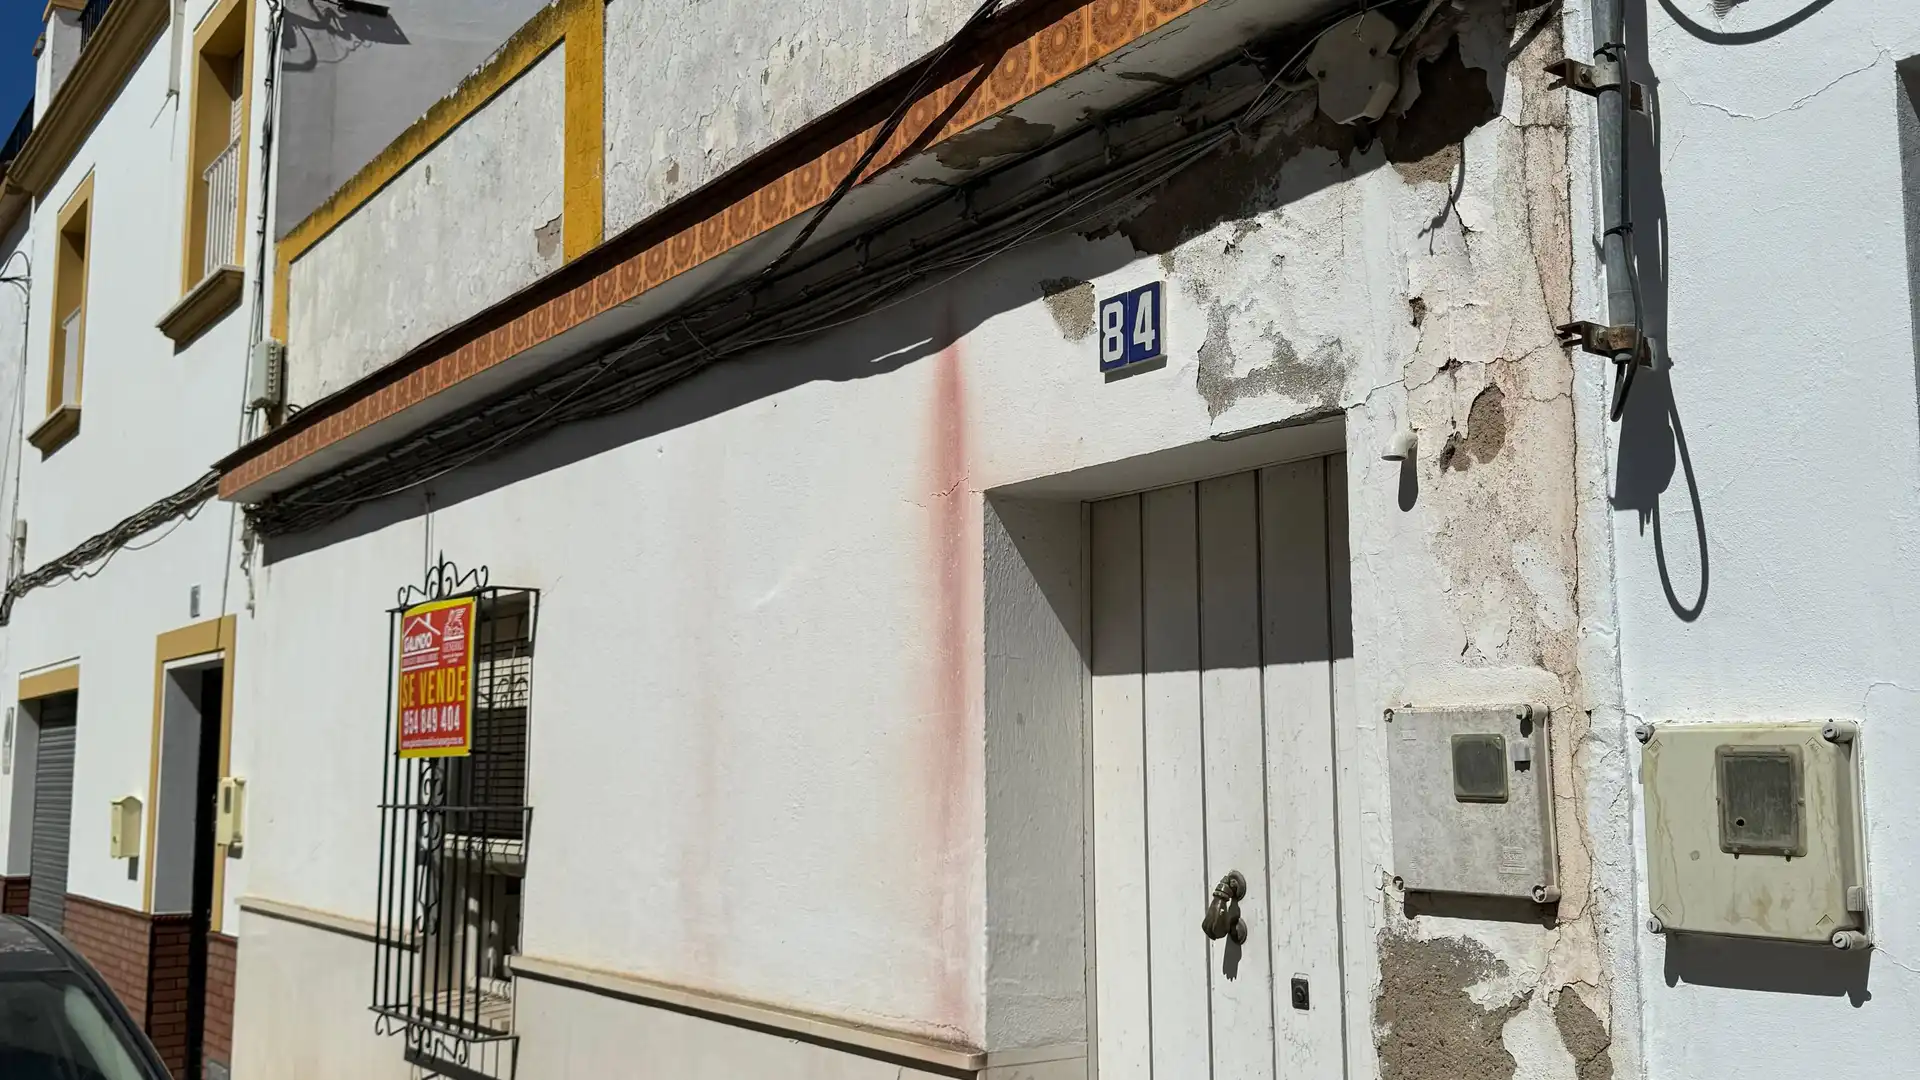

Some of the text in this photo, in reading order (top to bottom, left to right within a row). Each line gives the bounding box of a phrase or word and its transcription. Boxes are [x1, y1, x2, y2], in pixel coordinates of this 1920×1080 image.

[1102, 290, 1156, 363] 84
[402, 666, 466, 708] SE VENDE
[421, 706, 437, 733] 849
[440, 704, 461, 732] 404
